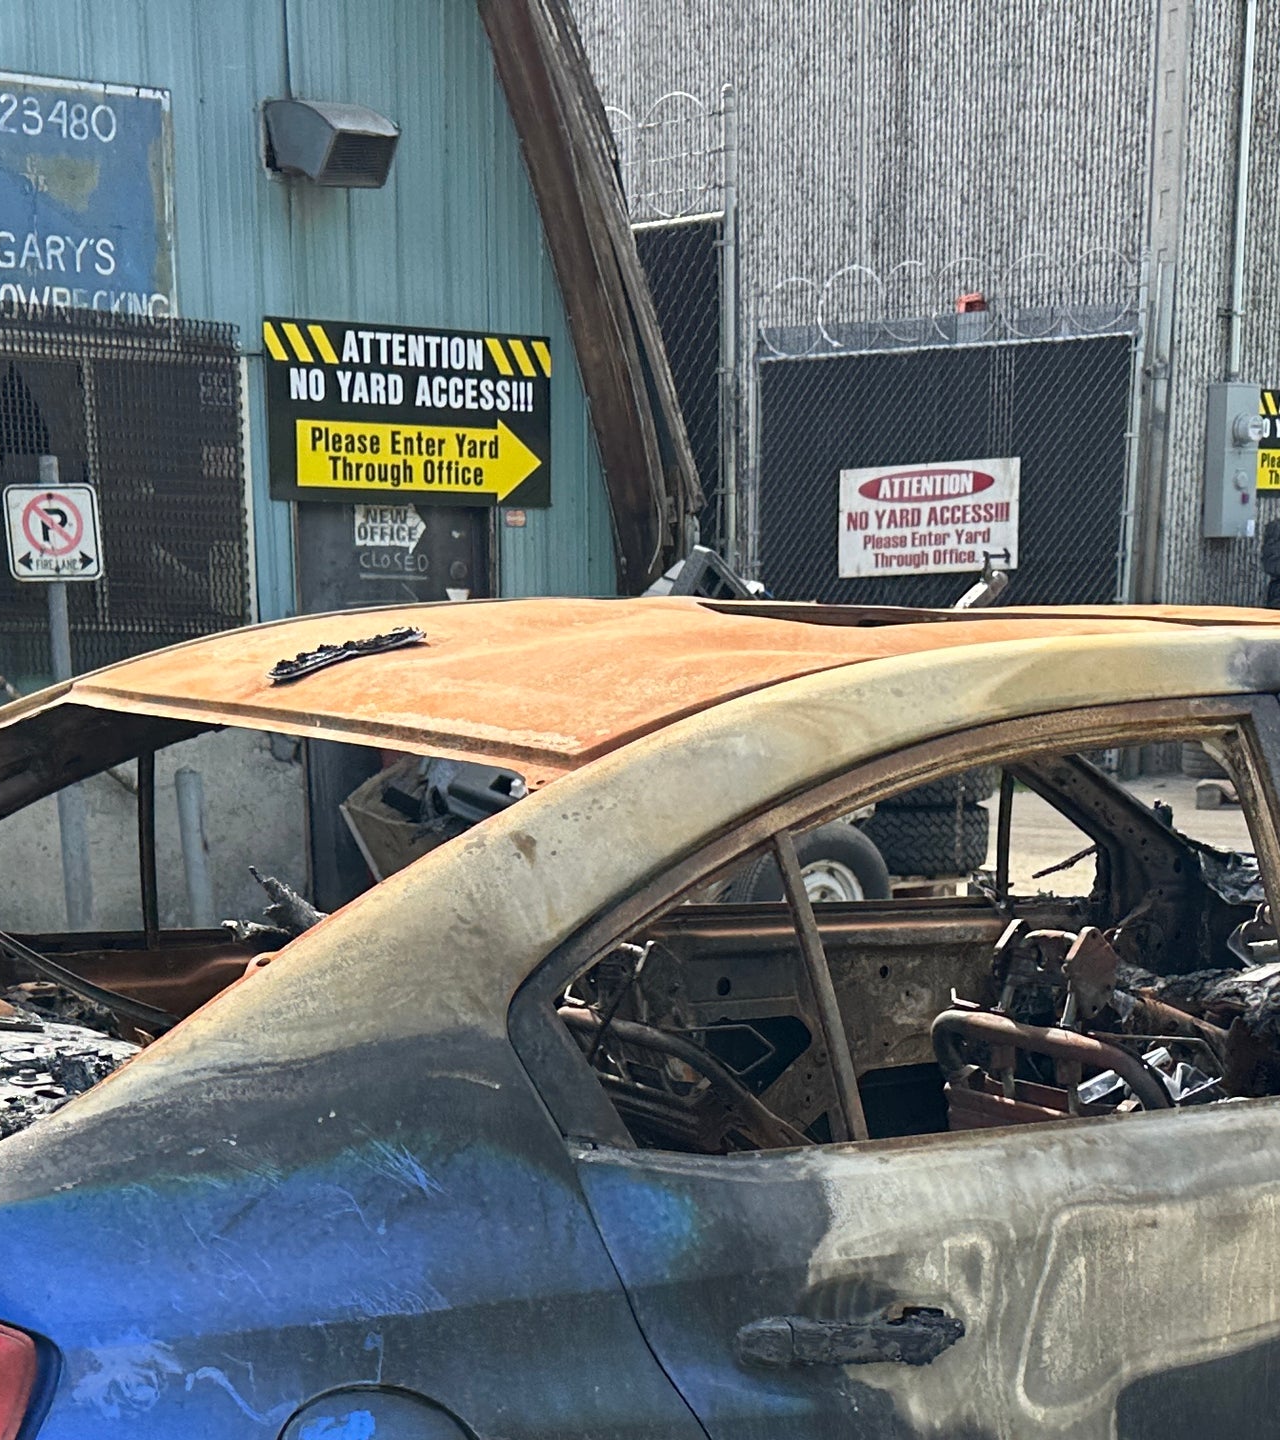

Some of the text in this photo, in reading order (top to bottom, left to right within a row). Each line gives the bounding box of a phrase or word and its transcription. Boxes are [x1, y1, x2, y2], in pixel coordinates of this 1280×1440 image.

[341, 329, 484, 371] ATTENTION
[289, 367, 534, 413] NO YARD ACCESS!!!
[310, 427, 499, 460] Please Enter Yard
[328, 456, 484, 488] Through Office
[878, 472, 974, 499] ATTENTION
[364, 507, 408, 525] NEW
[847, 502, 1010, 531] NO YARD ACCESS!!!
[357, 526, 419, 542] OFFICE
[863, 527, 991, 550] Please Enter Yard
[36, 558, 80, 571] FIRE LANE
[359, 553, 429, 572] CLOSED
[874, 552, 929, 569] Through
